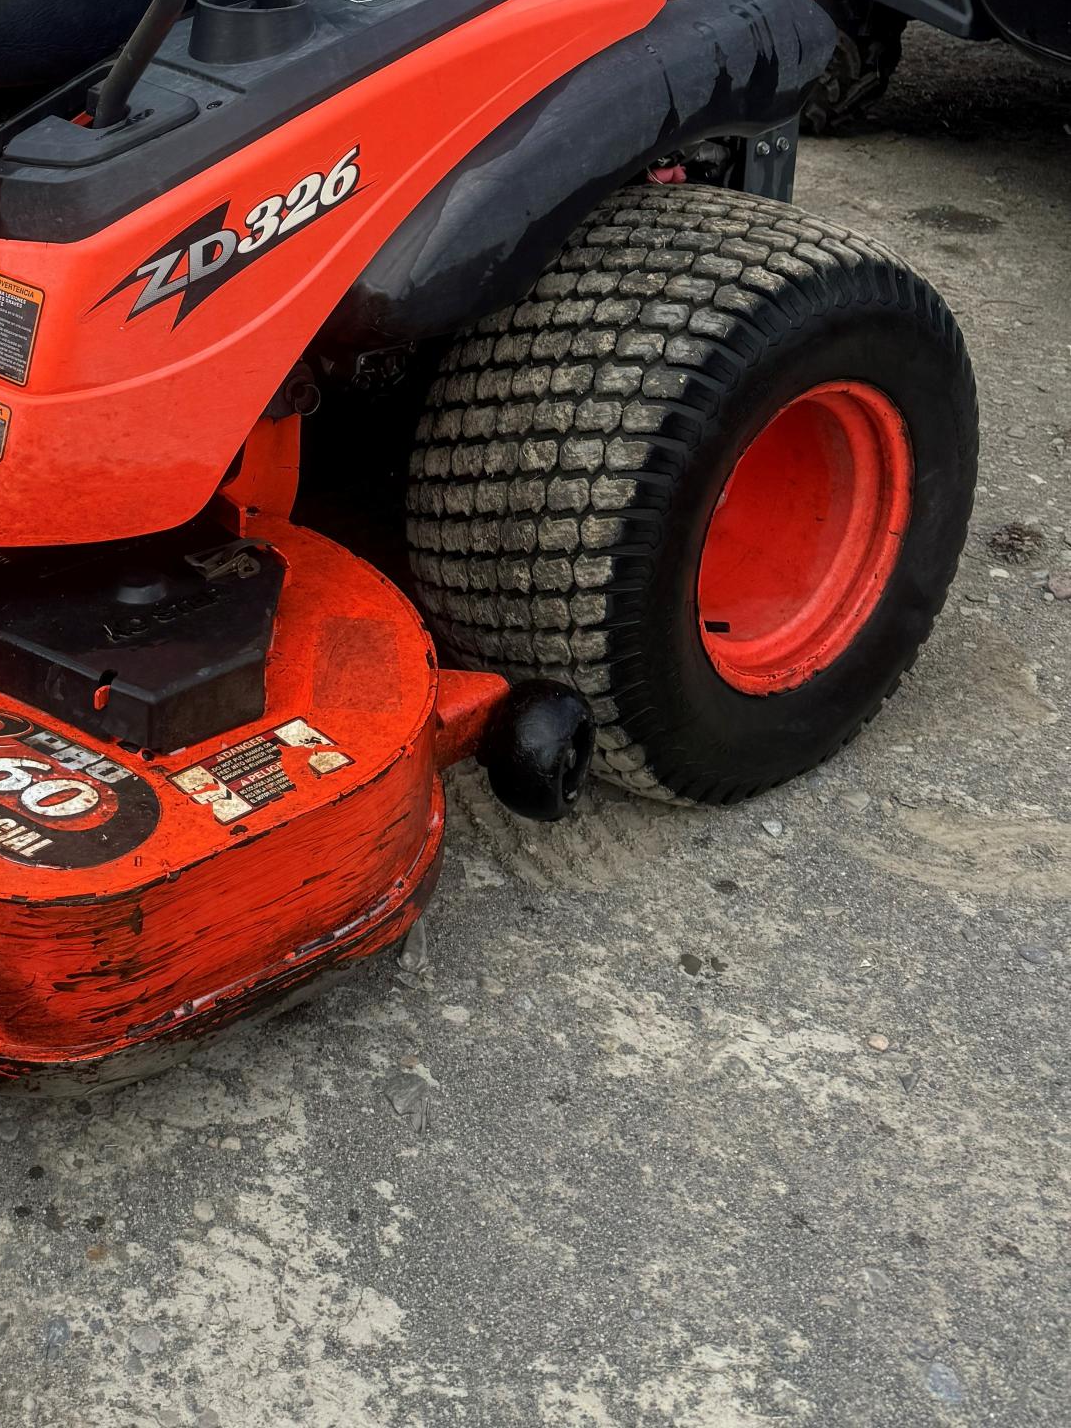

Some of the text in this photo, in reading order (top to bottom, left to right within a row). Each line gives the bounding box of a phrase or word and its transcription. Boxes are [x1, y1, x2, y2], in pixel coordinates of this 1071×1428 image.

[129, 145, 361, 315] ZD326
[22, 729, 133, 785] PRO
[220, 759, 234, 768] NOT
[233, 754, 245, 763] PUT
[244, 746, 264, 758] HANDS
[224, 736, 266, 758] DANGER
[245, 751, 267, 763] MOWER
